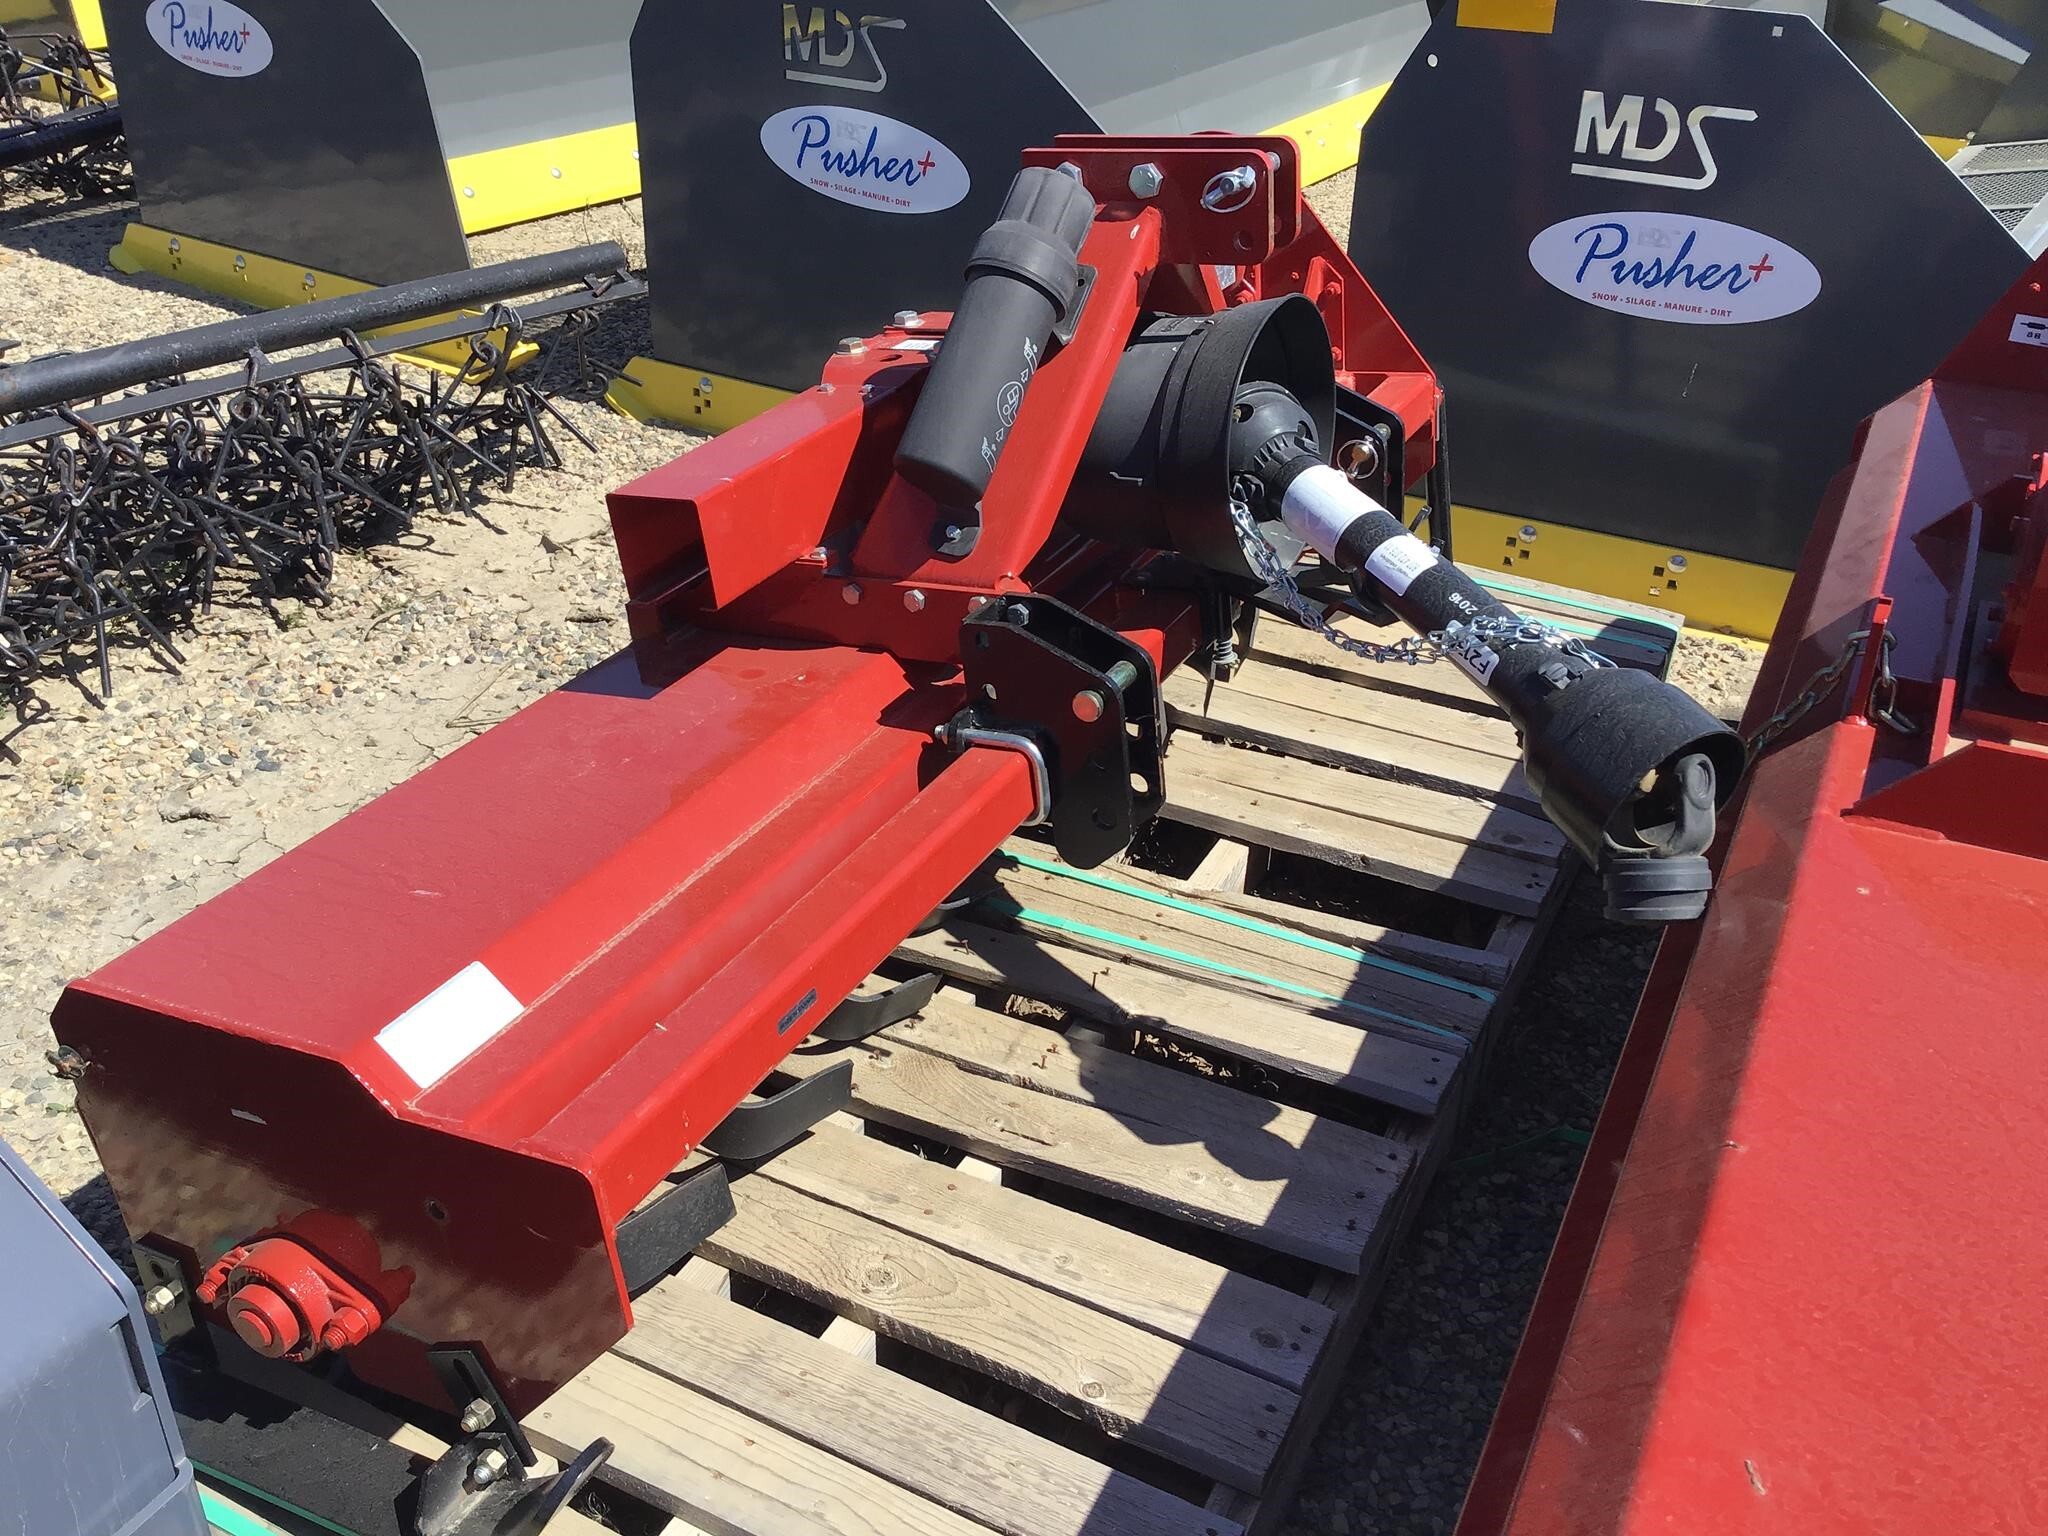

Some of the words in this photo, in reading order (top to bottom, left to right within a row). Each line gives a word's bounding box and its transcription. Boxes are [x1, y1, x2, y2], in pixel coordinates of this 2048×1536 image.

[782, 3, 907, 93] MDS
[1571, 89, 1758, 191] MDS
[810, 178, 829, 188] SNOW
[834, 183, 858, 195] SILAGE
[862, 190, 890, 203] MANURE
[895, 198, 911, 208] DIRT
[1592, 292, 1618, 303] SNOW
[1625, 297, 1657, 308] SILAGE
[1664, 302, 1702, 314] MANURE
[1710, 308, 1733, 318] DIRT
[1448, 592, 1478, 615] 2016
